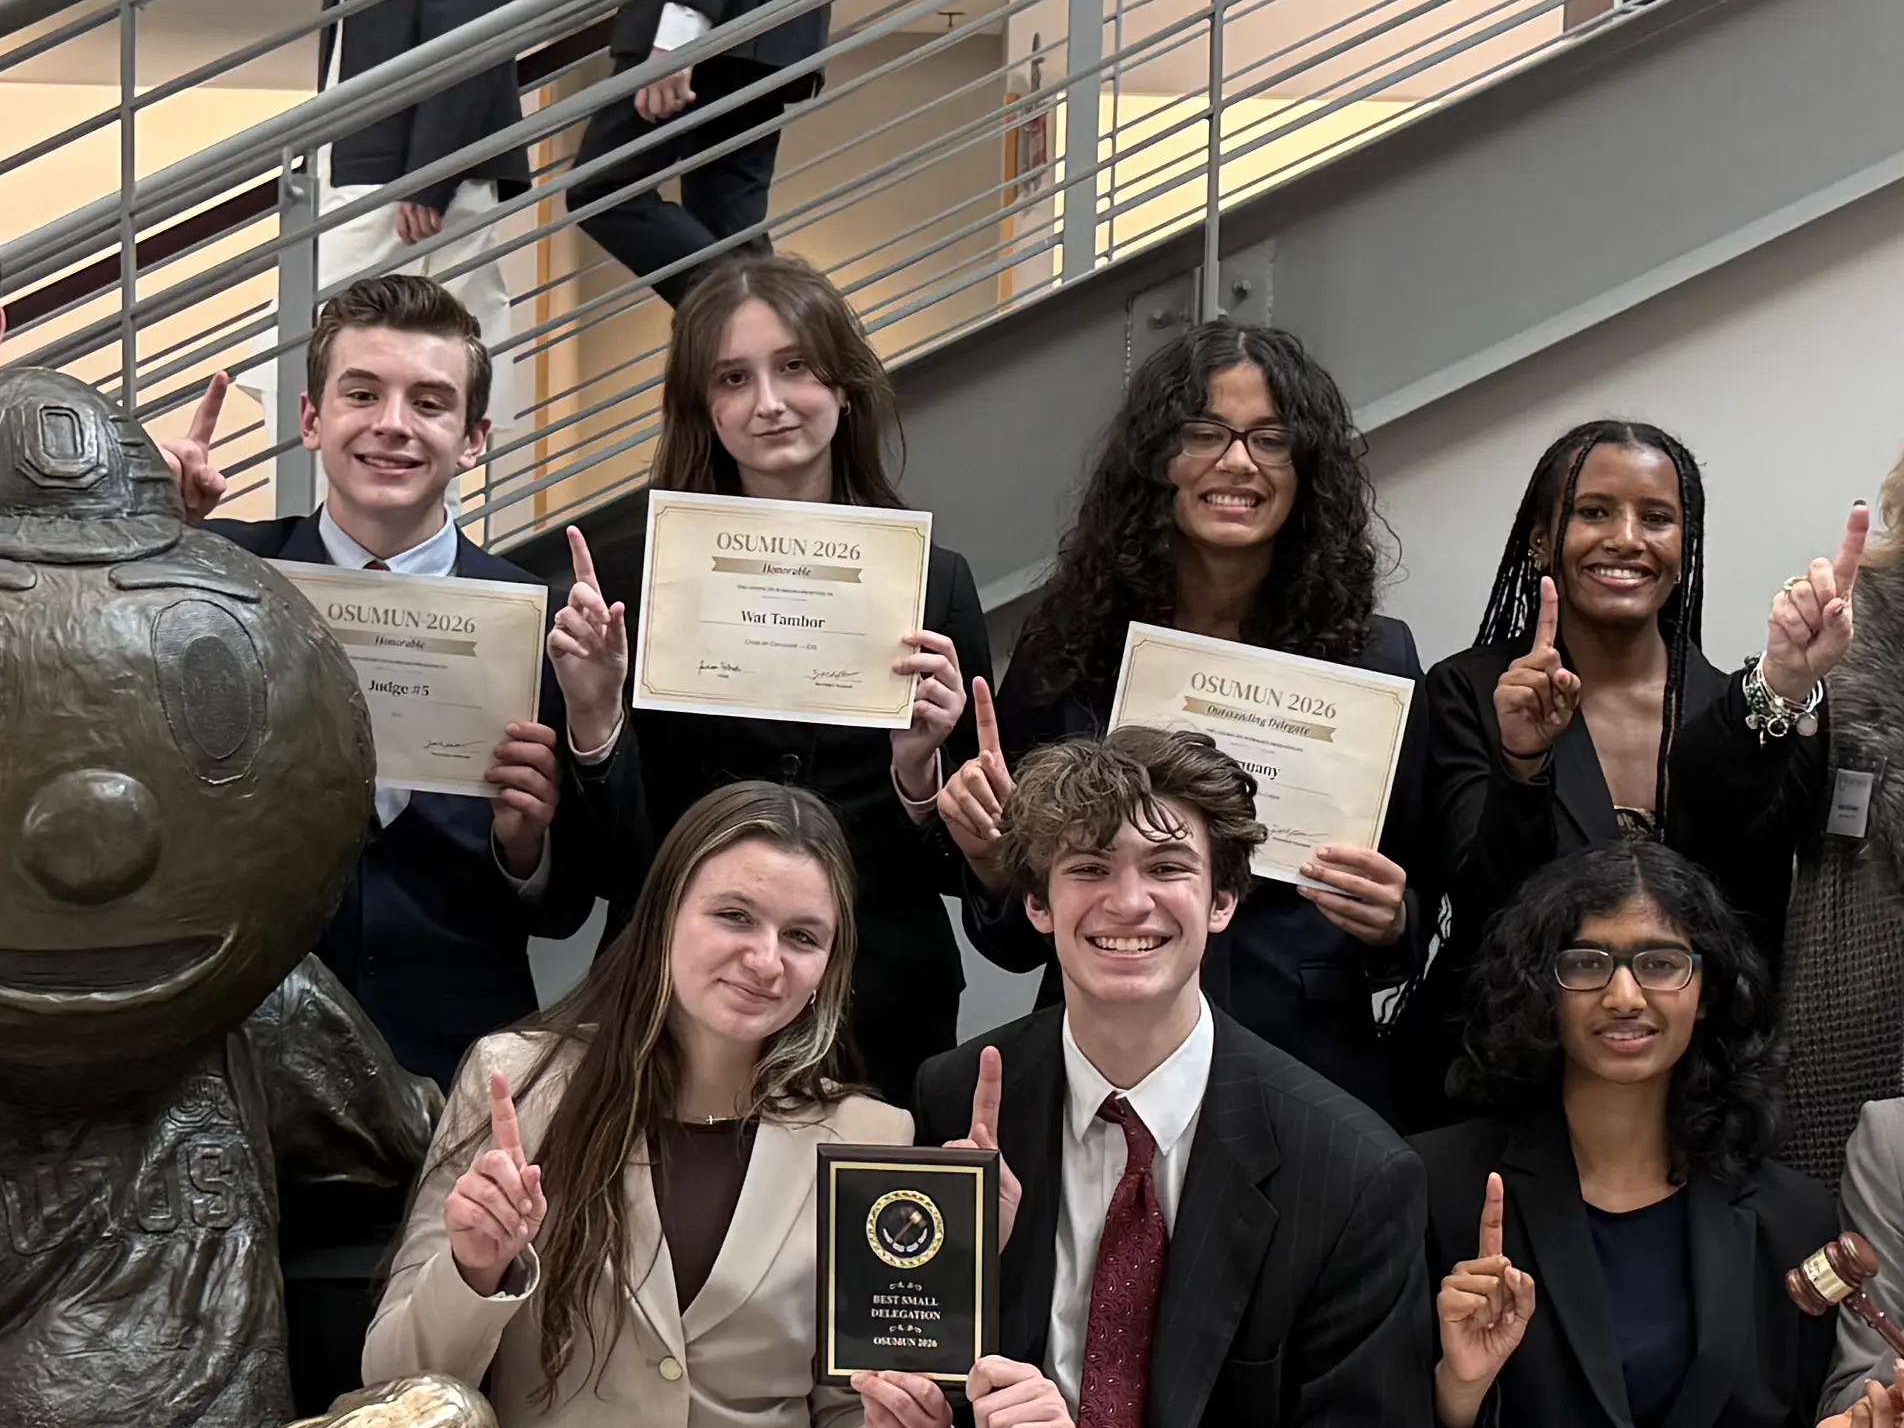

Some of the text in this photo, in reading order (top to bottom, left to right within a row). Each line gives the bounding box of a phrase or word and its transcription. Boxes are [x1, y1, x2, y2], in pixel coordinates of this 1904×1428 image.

[717, 531, 861, 561] OSUMUN 2026
[327, 602, 476, 634] OSUMUN 2026
[741, 609, 825, 629] Wat Tambor
[368, 678, 409, 697] Judge
[1191, 671, 1337, 720] OSUMUN 2026
[873, 1295, 938, 1306] BEST SMALL
[871, 1309, 941, 1320] DELEGATION
[873, 1337, 937, 1348] OSUMUN 2026
